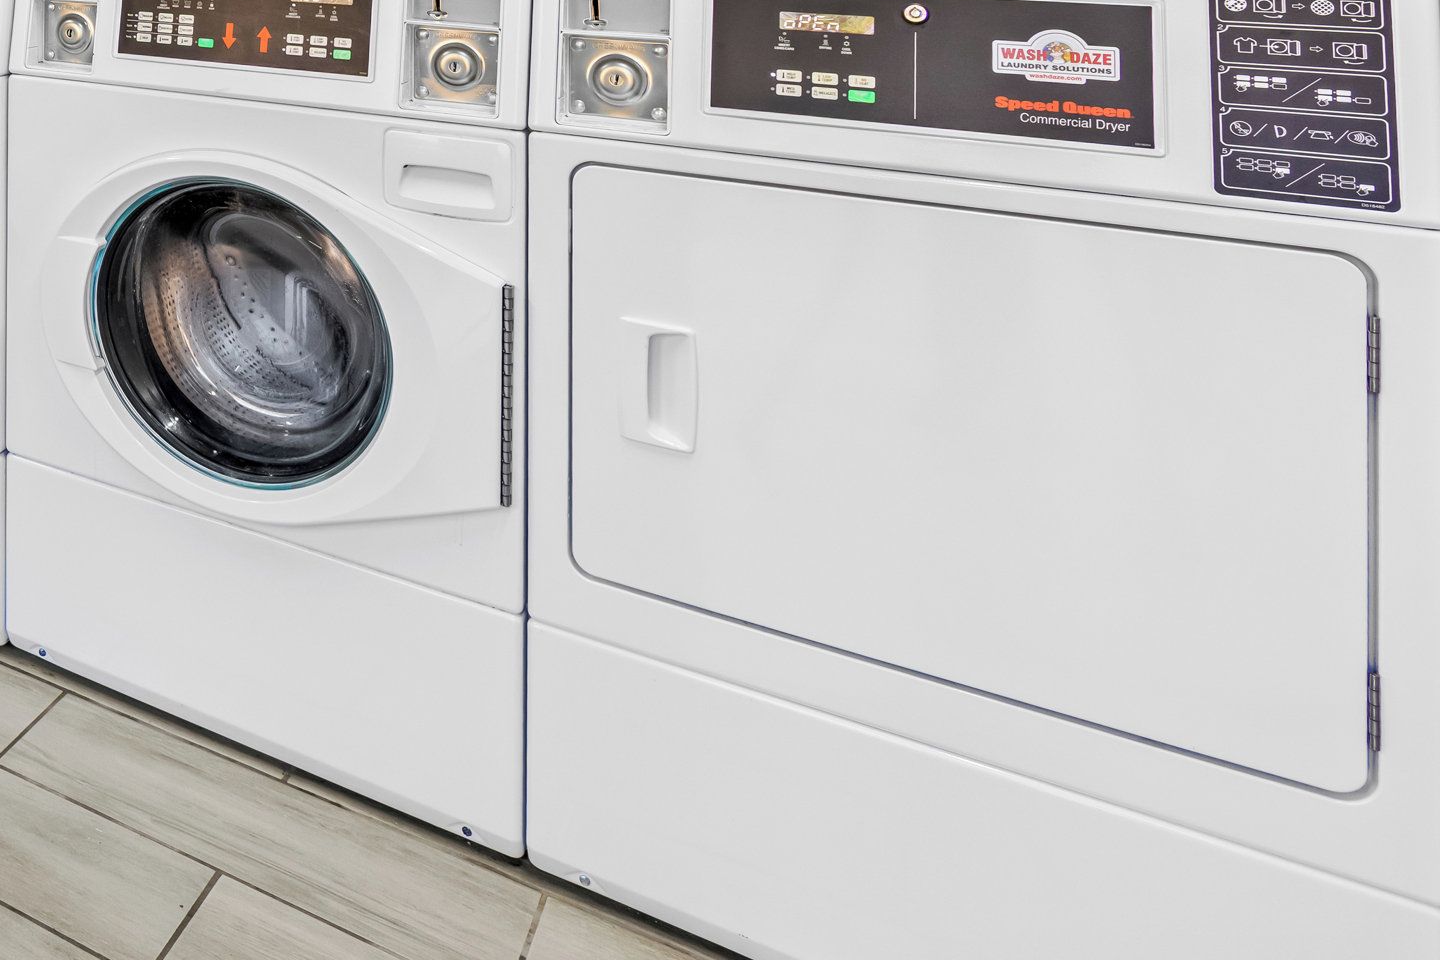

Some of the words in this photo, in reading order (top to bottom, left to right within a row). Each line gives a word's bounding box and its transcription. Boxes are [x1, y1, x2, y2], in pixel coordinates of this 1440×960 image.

[1001, 47, 1048, 62] WASH
[1070, 51, 1112, 66] DAZE
[1001, 62, 1048, 70] LAUNDRY
[1052, 65, 1112, 75] SOLUTIONS
[1030, 73, 1082, 81] washdaze.com
[994, 96, 1059, 112] Speed
[1063, 101, 1132, 119] Queen
[1020, 112, 1092, 129] Commercial
[1096, 119, 1131, 133] Dryer
